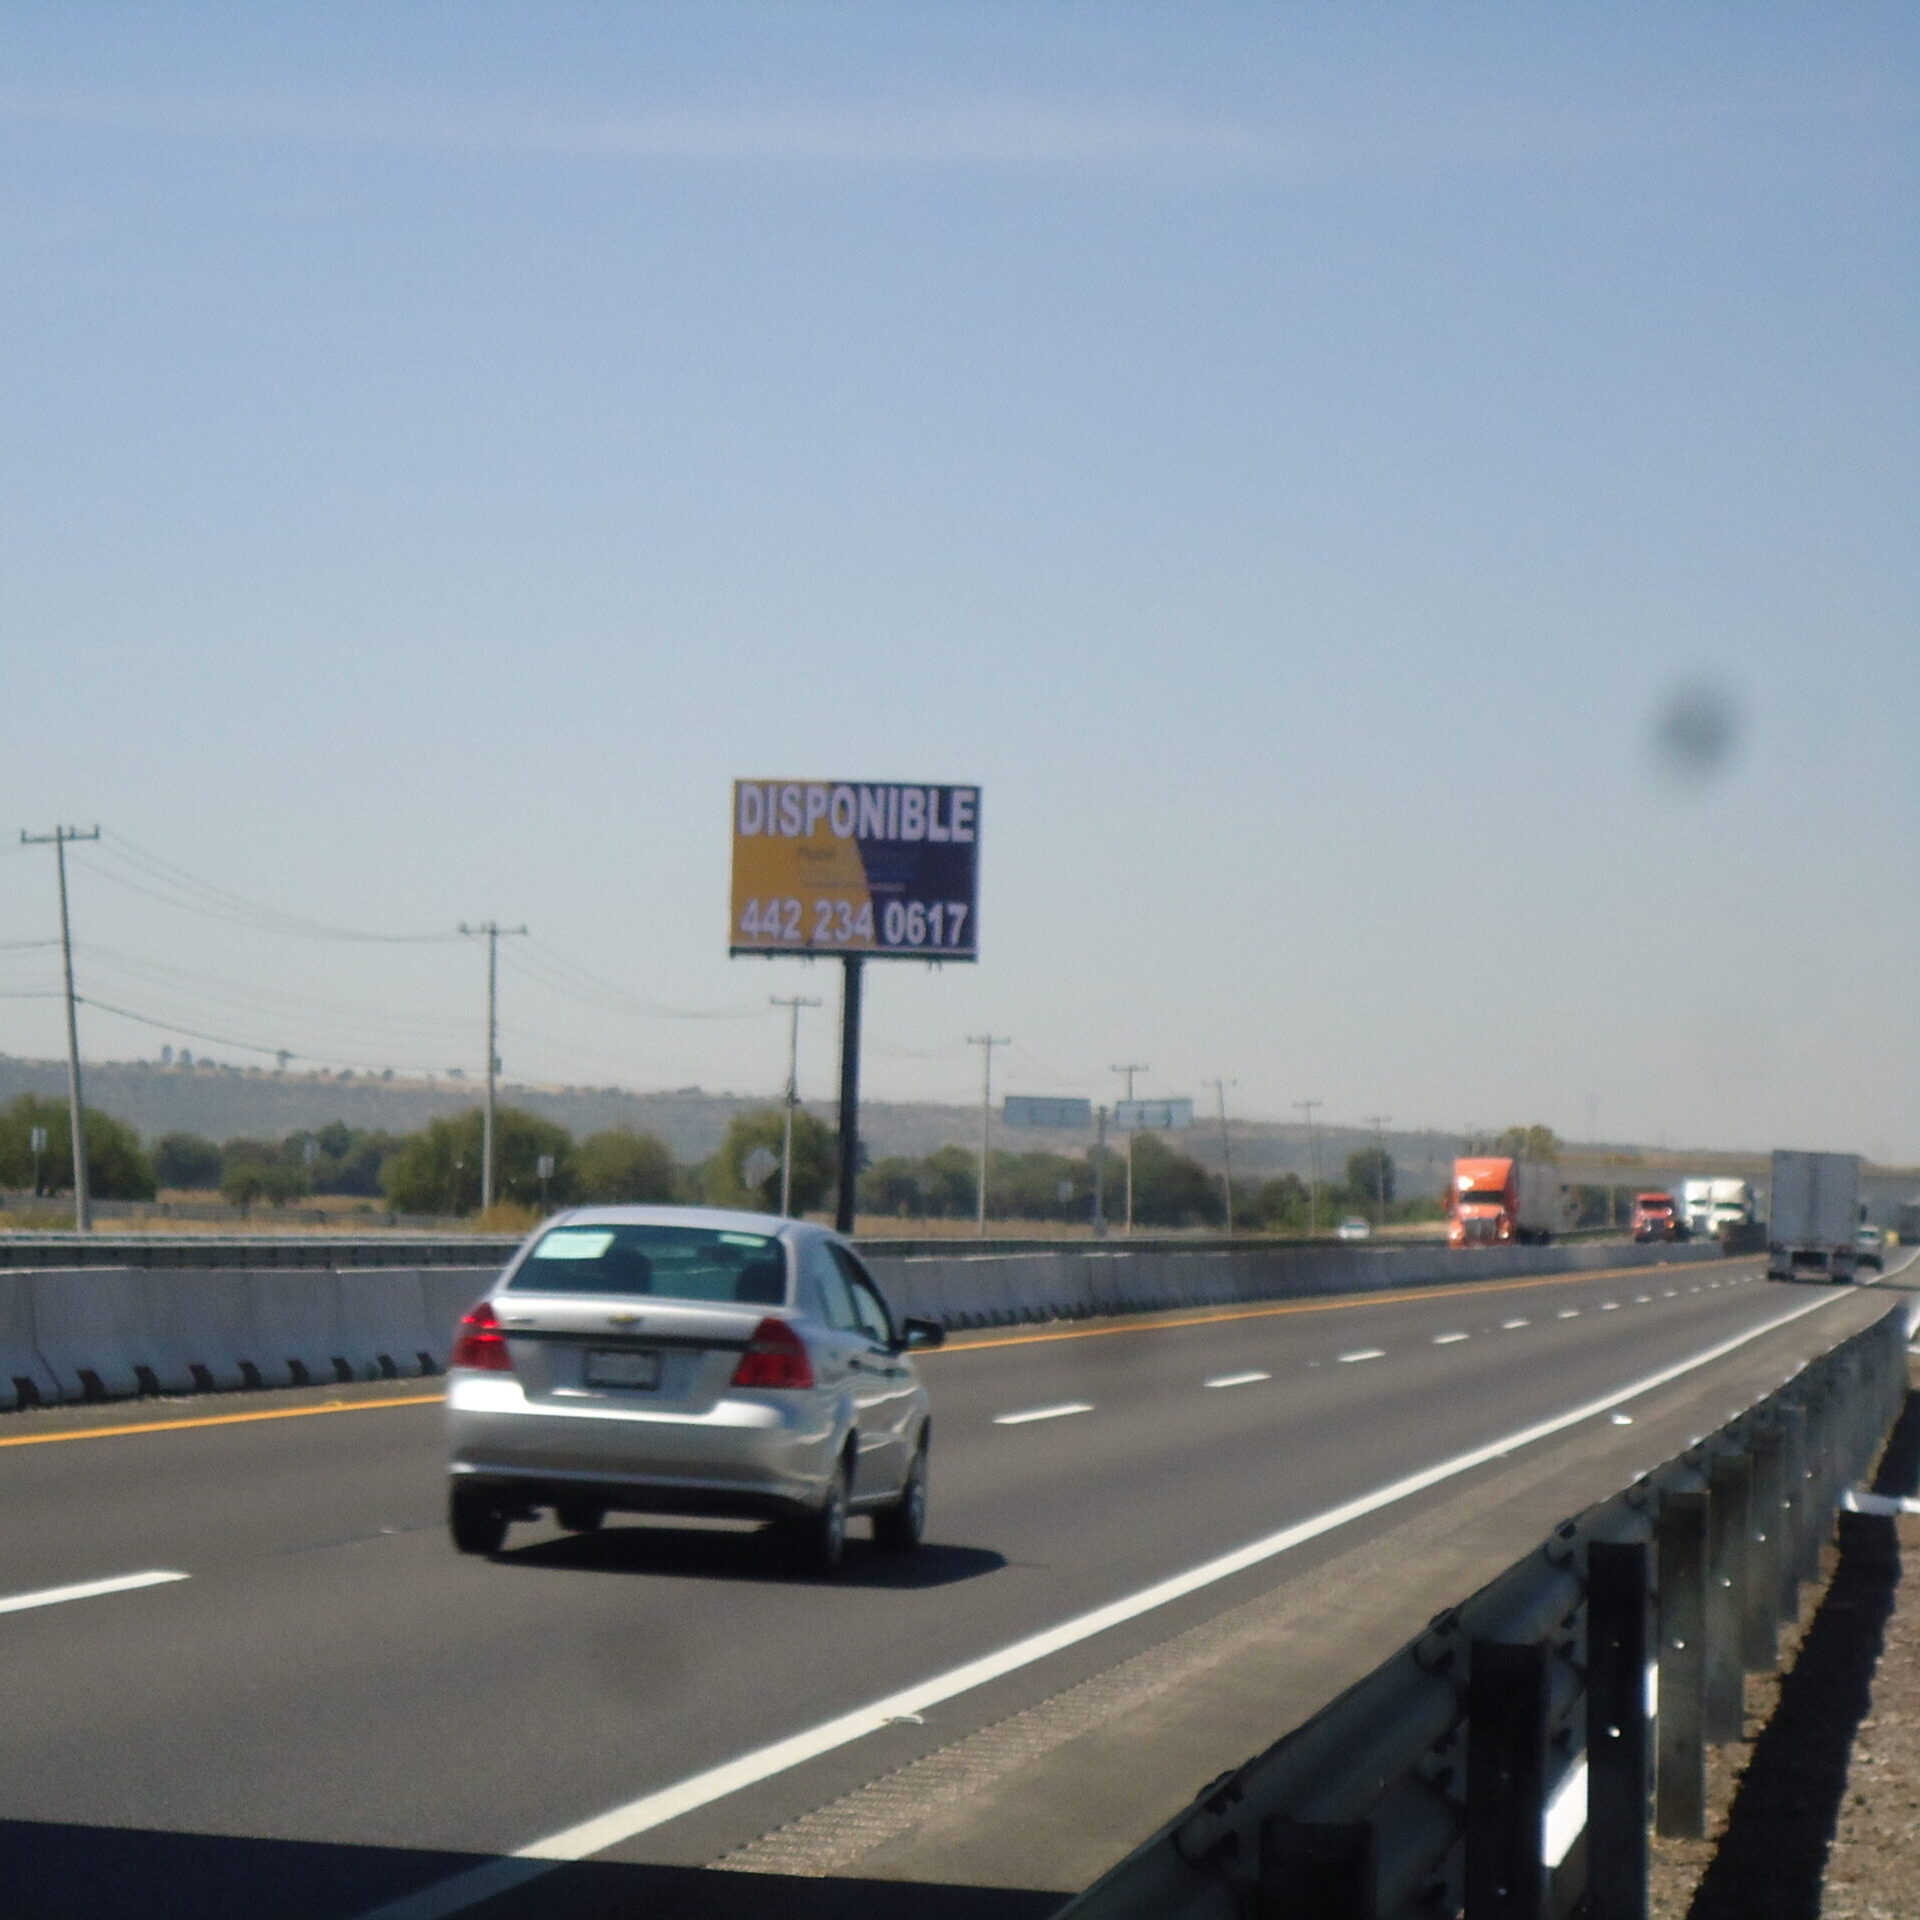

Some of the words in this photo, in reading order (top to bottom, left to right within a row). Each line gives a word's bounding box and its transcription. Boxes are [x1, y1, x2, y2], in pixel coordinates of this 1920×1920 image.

[739, 783, 976, 843] DISPONIBLE
[741, 898, 802, 940] 442
[813, 899, 874, 943] 234
[884, 901, 969, 946] 0617
